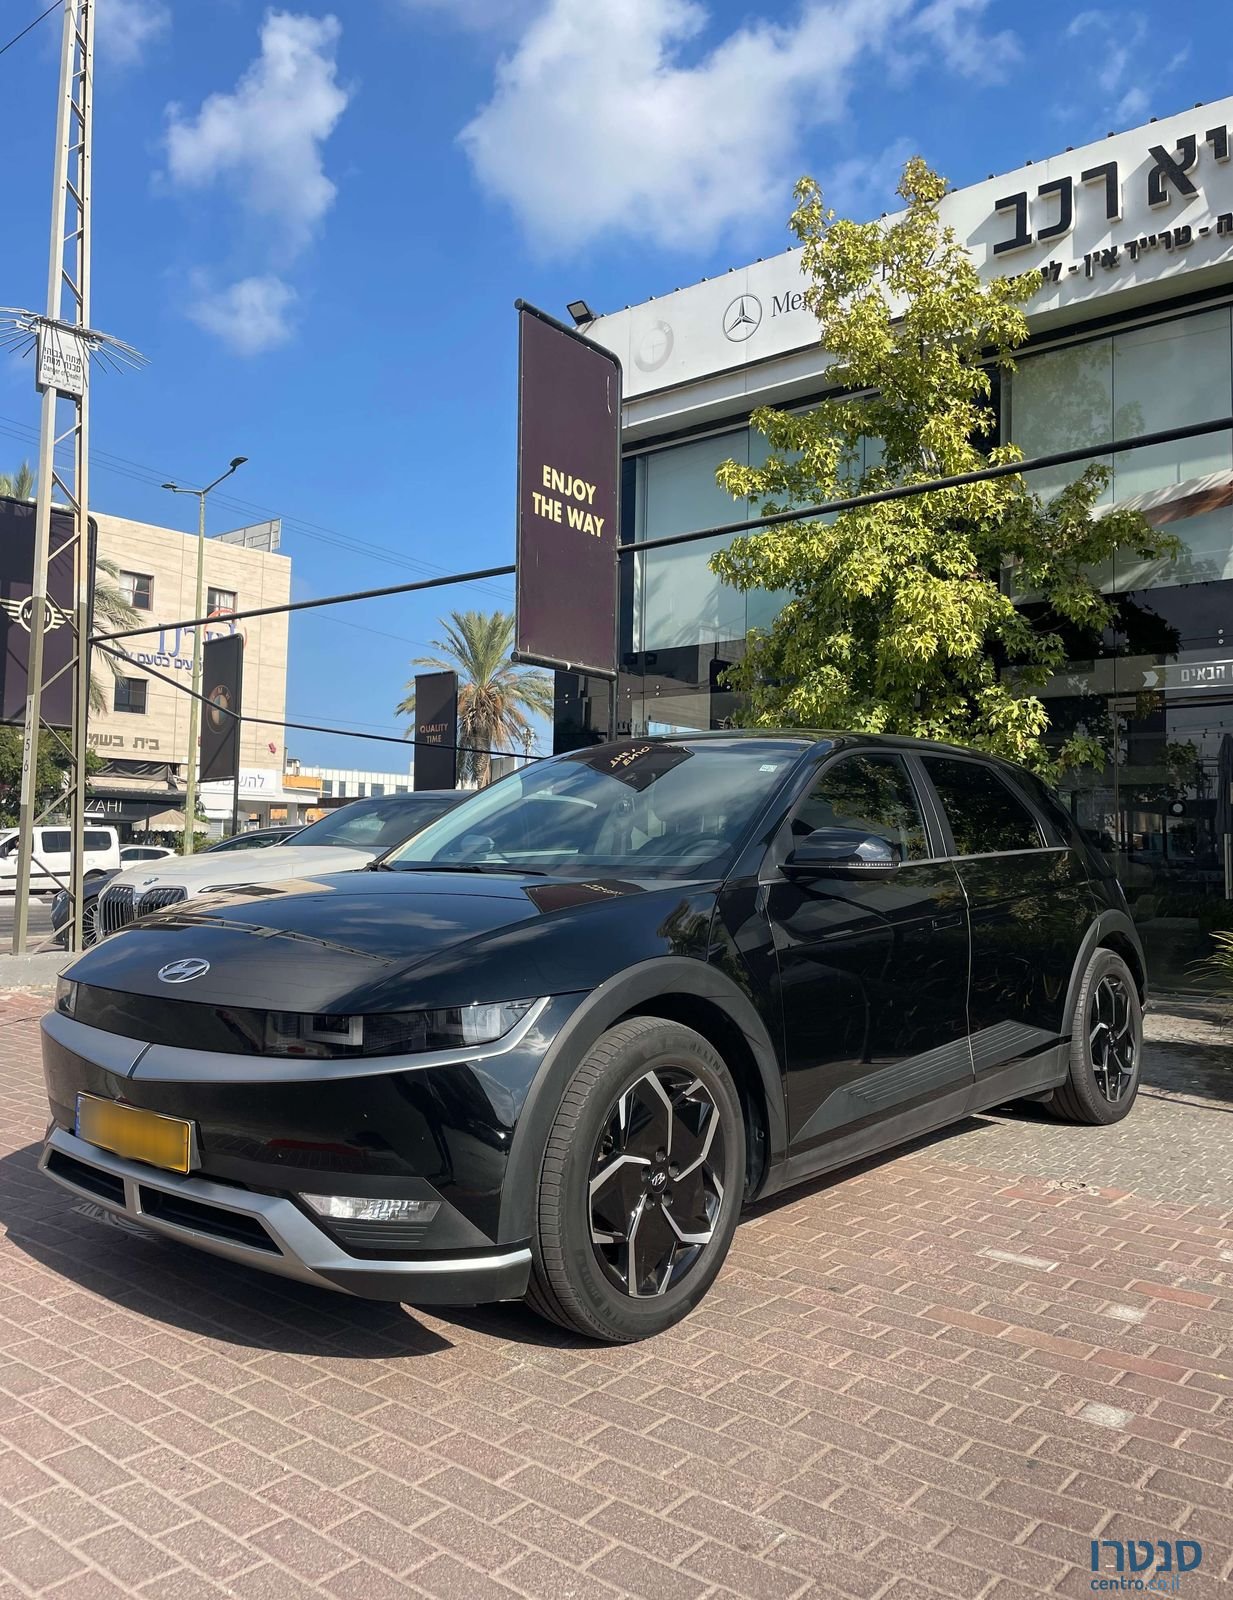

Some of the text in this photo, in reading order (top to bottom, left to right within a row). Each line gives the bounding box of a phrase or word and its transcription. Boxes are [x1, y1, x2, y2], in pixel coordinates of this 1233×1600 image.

[993, 160, 1120, 256] רכב
[1124, 225, 1192, 261] טרייד
[1083, 245, 1119, 279] אין
[543, 464, 597, 505] ENJOY
[532, 491, 605, 538] THE WAY
[23, 608, 50, 622] MI
[1180, 665, 1226, 682] הבאים
[419, 722, 449, 734] QUALITY
[426, 734, 442, 744] TIME
[87, 732, 160, 751] בית בשמ
